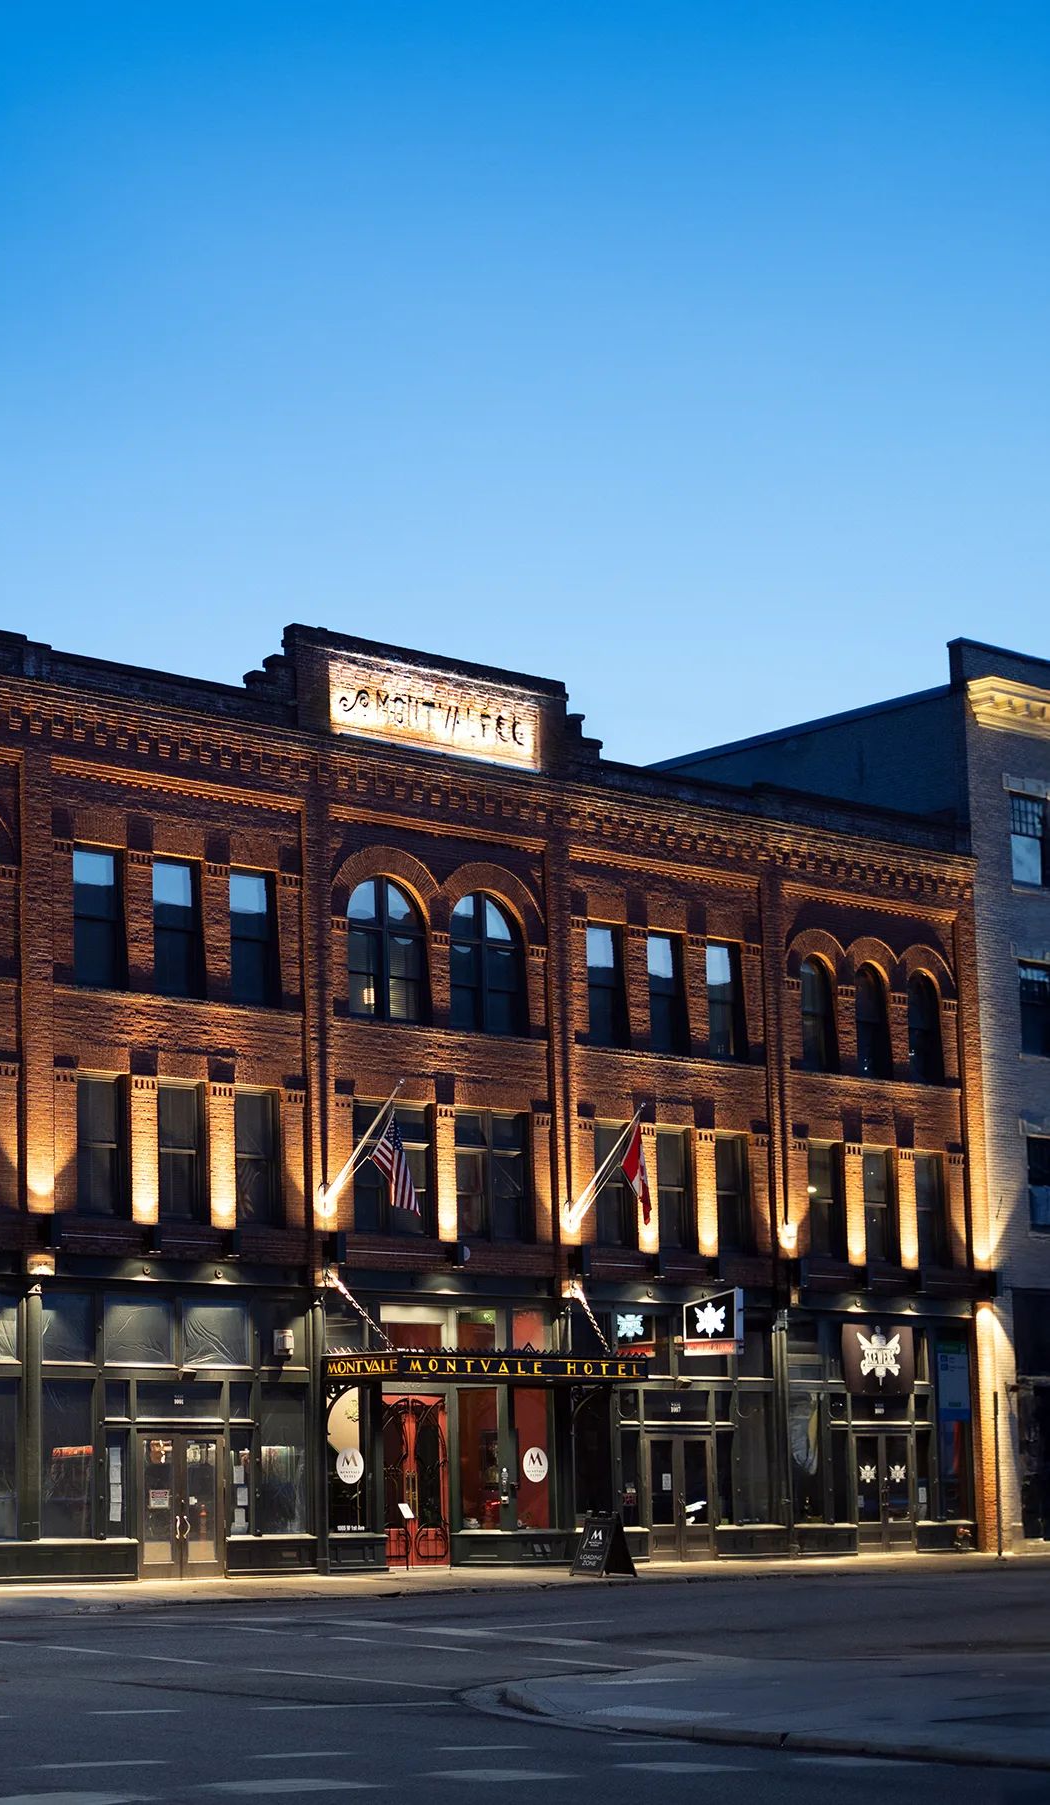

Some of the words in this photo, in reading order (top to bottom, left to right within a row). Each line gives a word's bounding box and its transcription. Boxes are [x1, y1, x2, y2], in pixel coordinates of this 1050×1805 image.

[864, 1349, 896, 1364] SKEWERS
[327, 1359, 398, 1374] MONTVALE
[409, 1358, 543, 1374] MONTVALE
[566, 1362, 641, 1376] HOTEL
